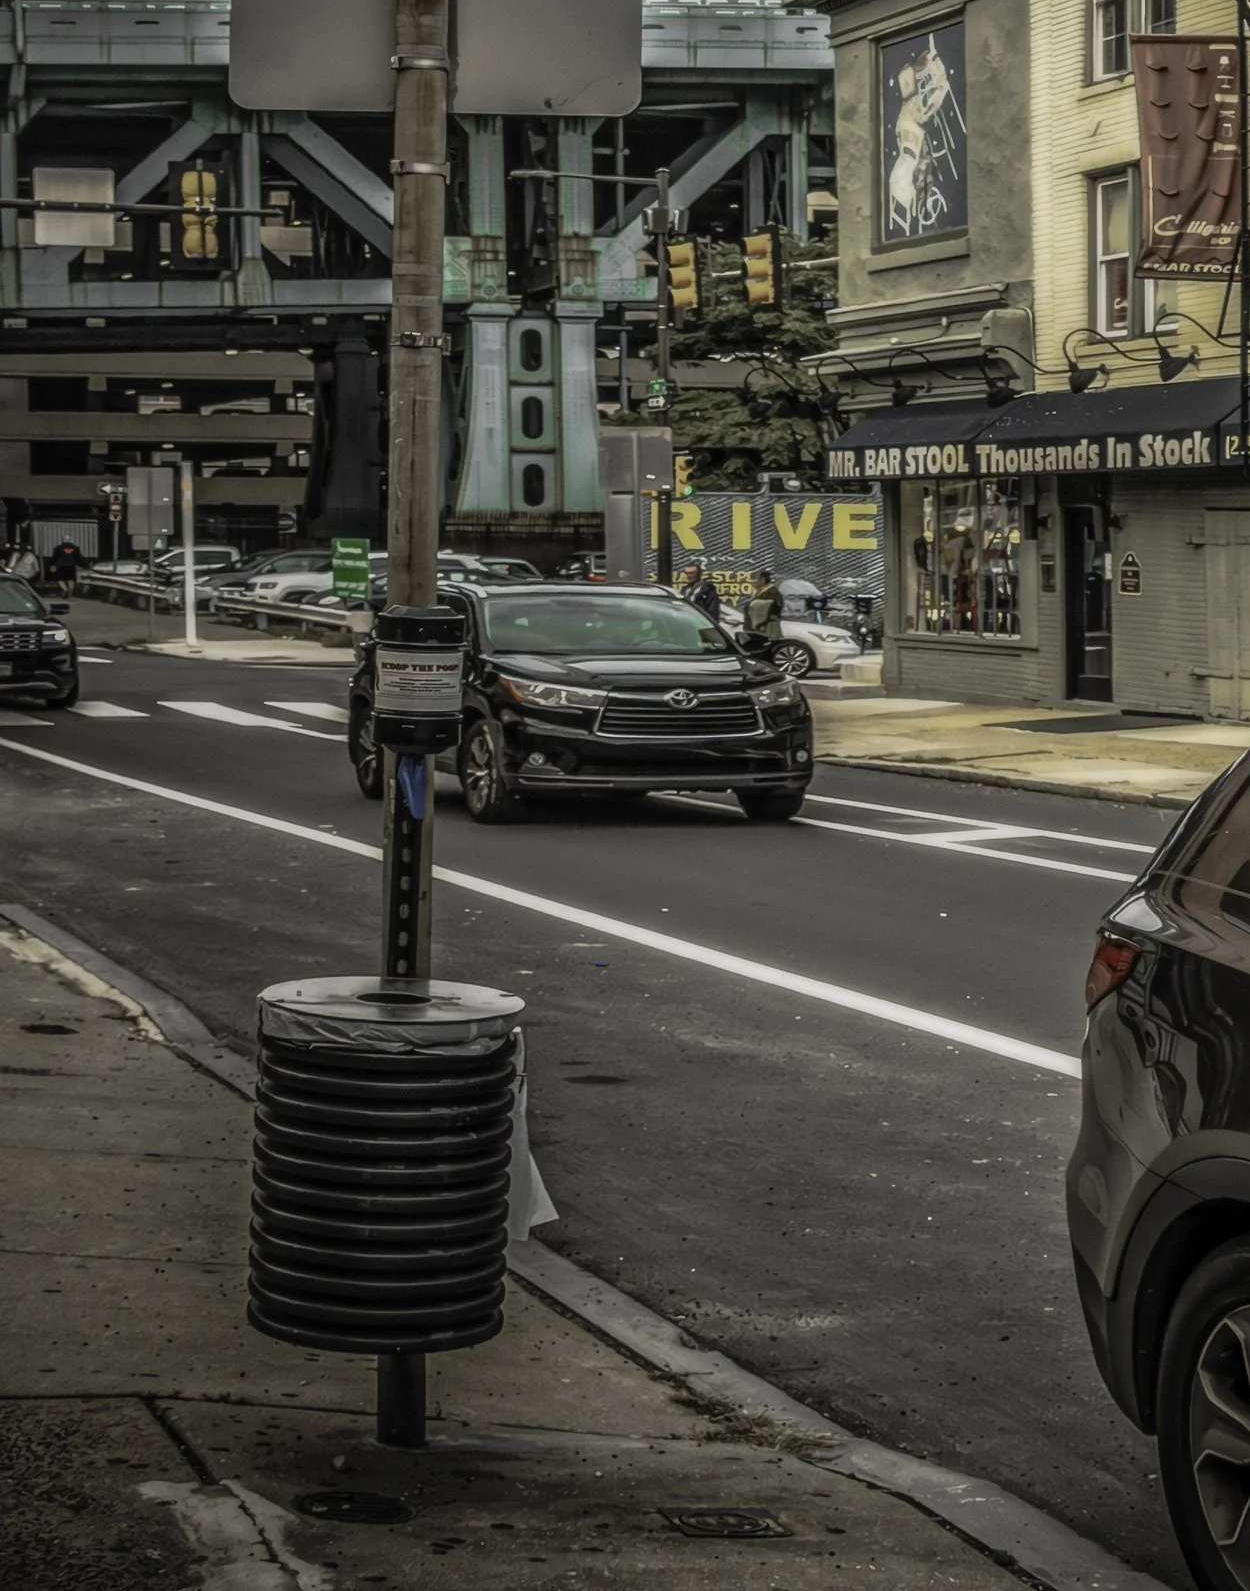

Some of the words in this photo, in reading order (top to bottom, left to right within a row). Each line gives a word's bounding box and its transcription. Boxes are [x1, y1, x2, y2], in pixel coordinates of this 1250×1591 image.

[828, 450, 860, 478] MR.
[864, 447, 902, 477] BAR
[905, 443, 970, 476] STOOL
[976, 440, 1100, 474] Thousands
[1106, 436, 1132, 469] In
[1138, 430, 1212, 467] Stock
[381, 661, 410, 671] SCOOP
[412, 663, 435, 672] THE
